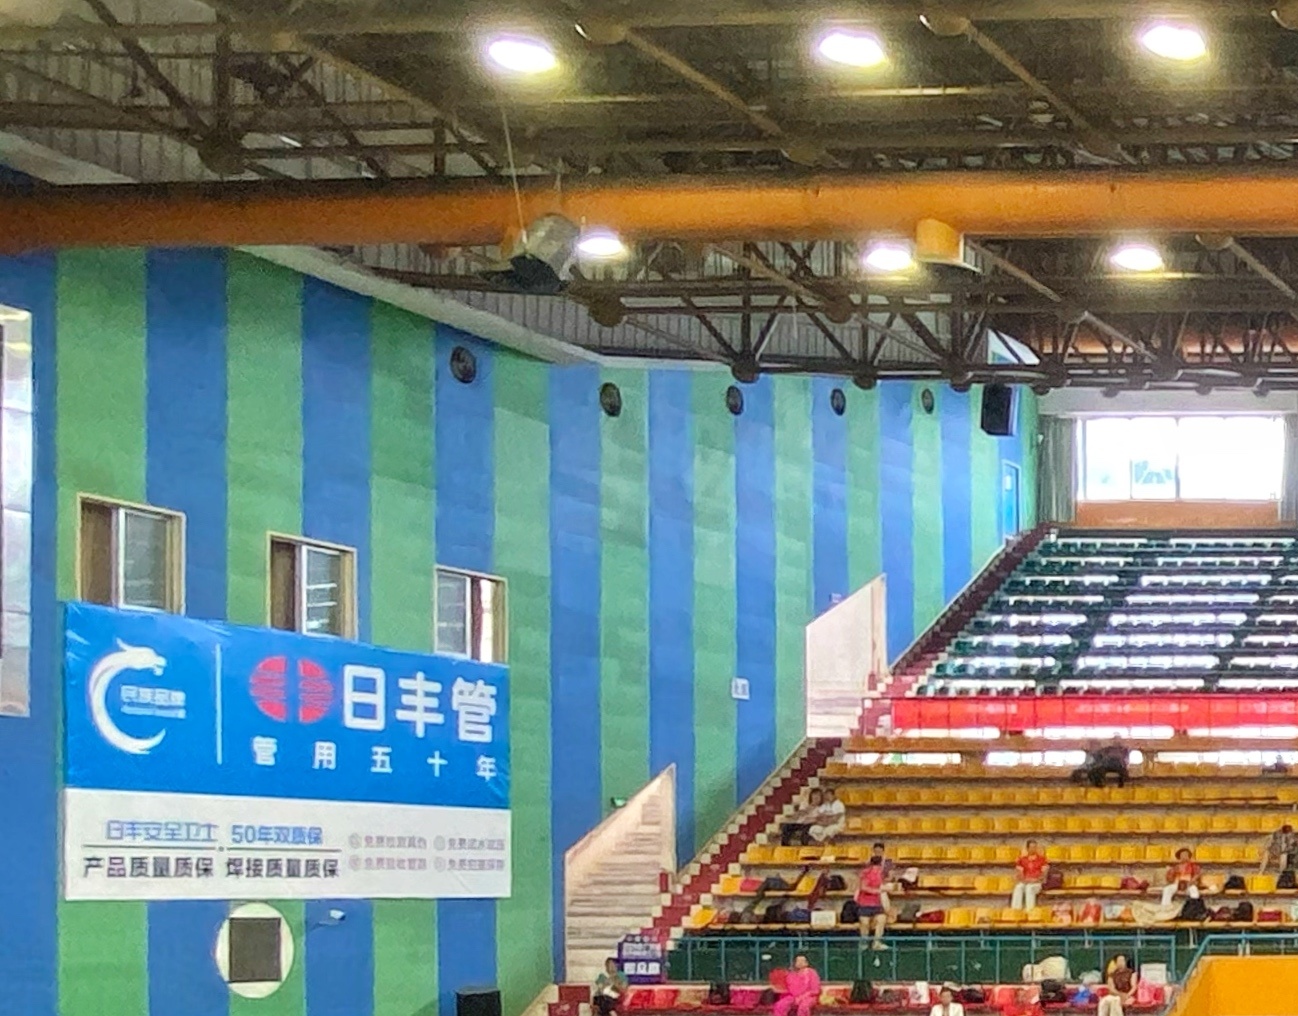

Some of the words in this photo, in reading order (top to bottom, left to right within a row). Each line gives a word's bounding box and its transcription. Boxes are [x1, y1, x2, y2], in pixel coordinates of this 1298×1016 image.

[343, 664, 498, 743] 日丰管
[251, 736, 498, 781] 管用五十年
[106, 820, 217, 842] 日丰安全卫士
[231, 824, 323, 845] 50年双质保
[83, 856, 214, 878] 产品质量质保
[225, 857, 339, 880] 焊接质量质保
